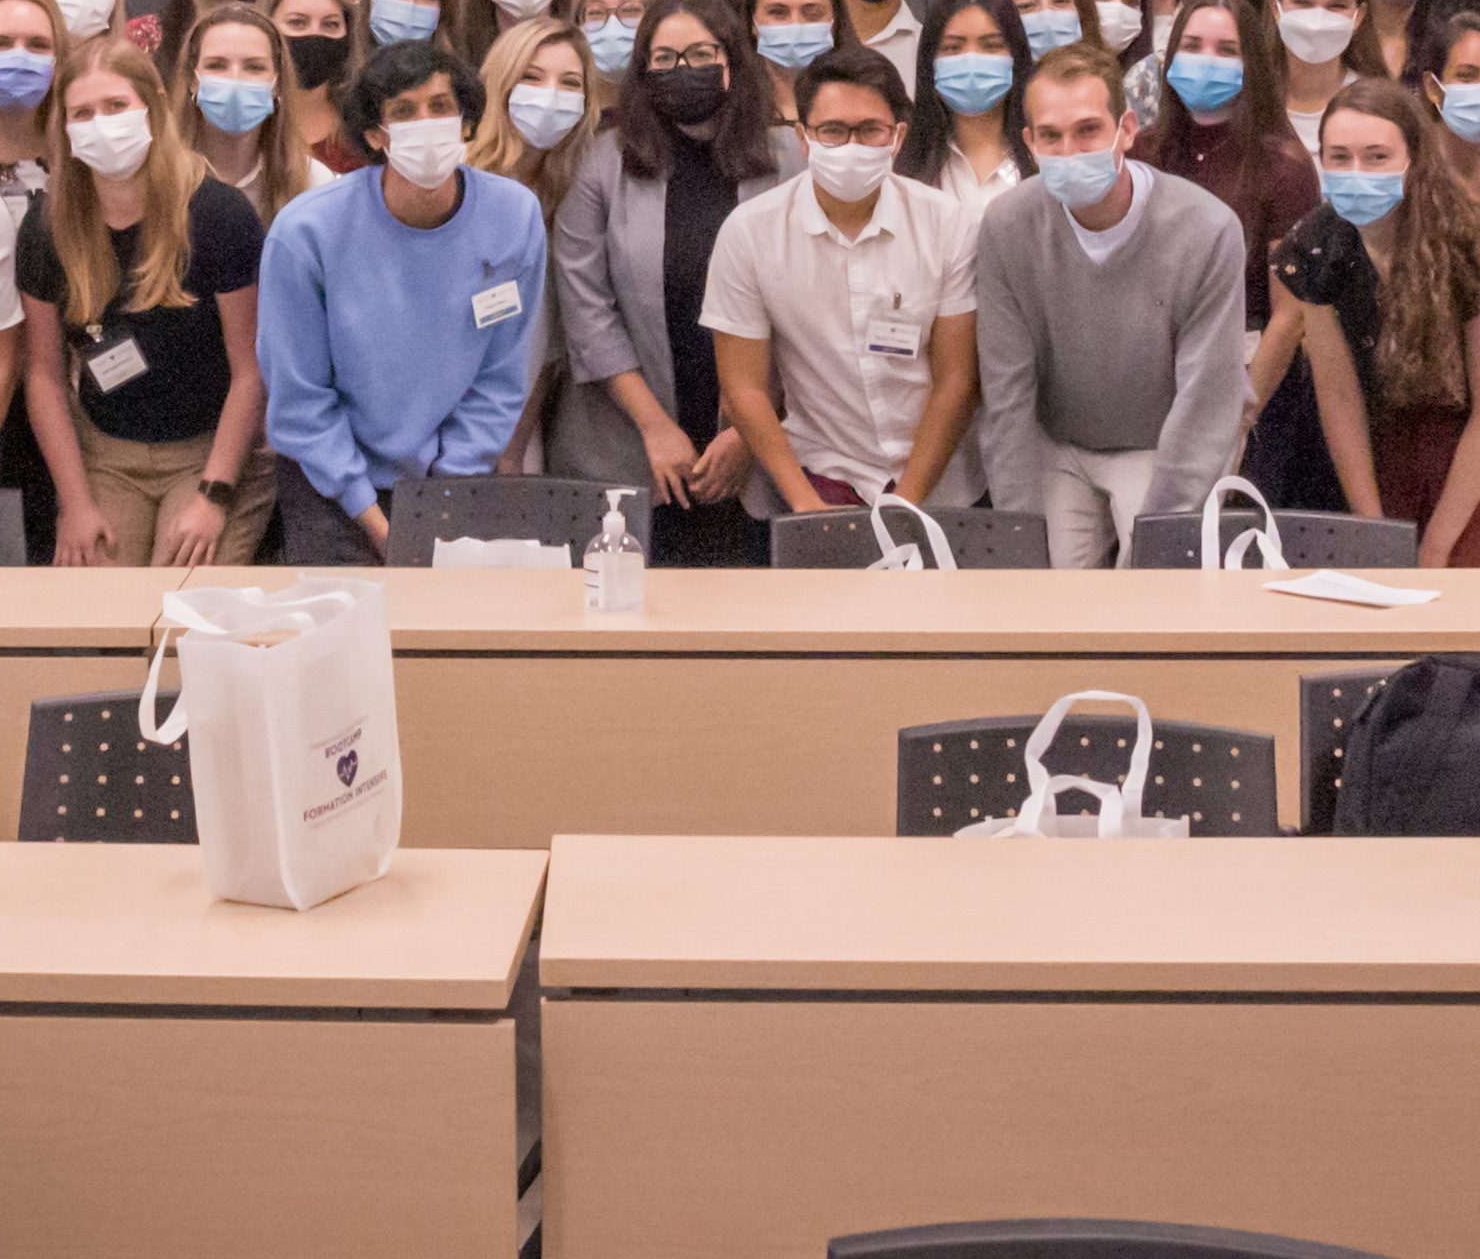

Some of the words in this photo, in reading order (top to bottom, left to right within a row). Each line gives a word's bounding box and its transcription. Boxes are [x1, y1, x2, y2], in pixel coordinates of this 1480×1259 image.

[324, 727, 362, 759] BOOTCAMP
[303, 791, 354, 822] FORMATION
[355, 769, 388, 797] INTENSIVE
